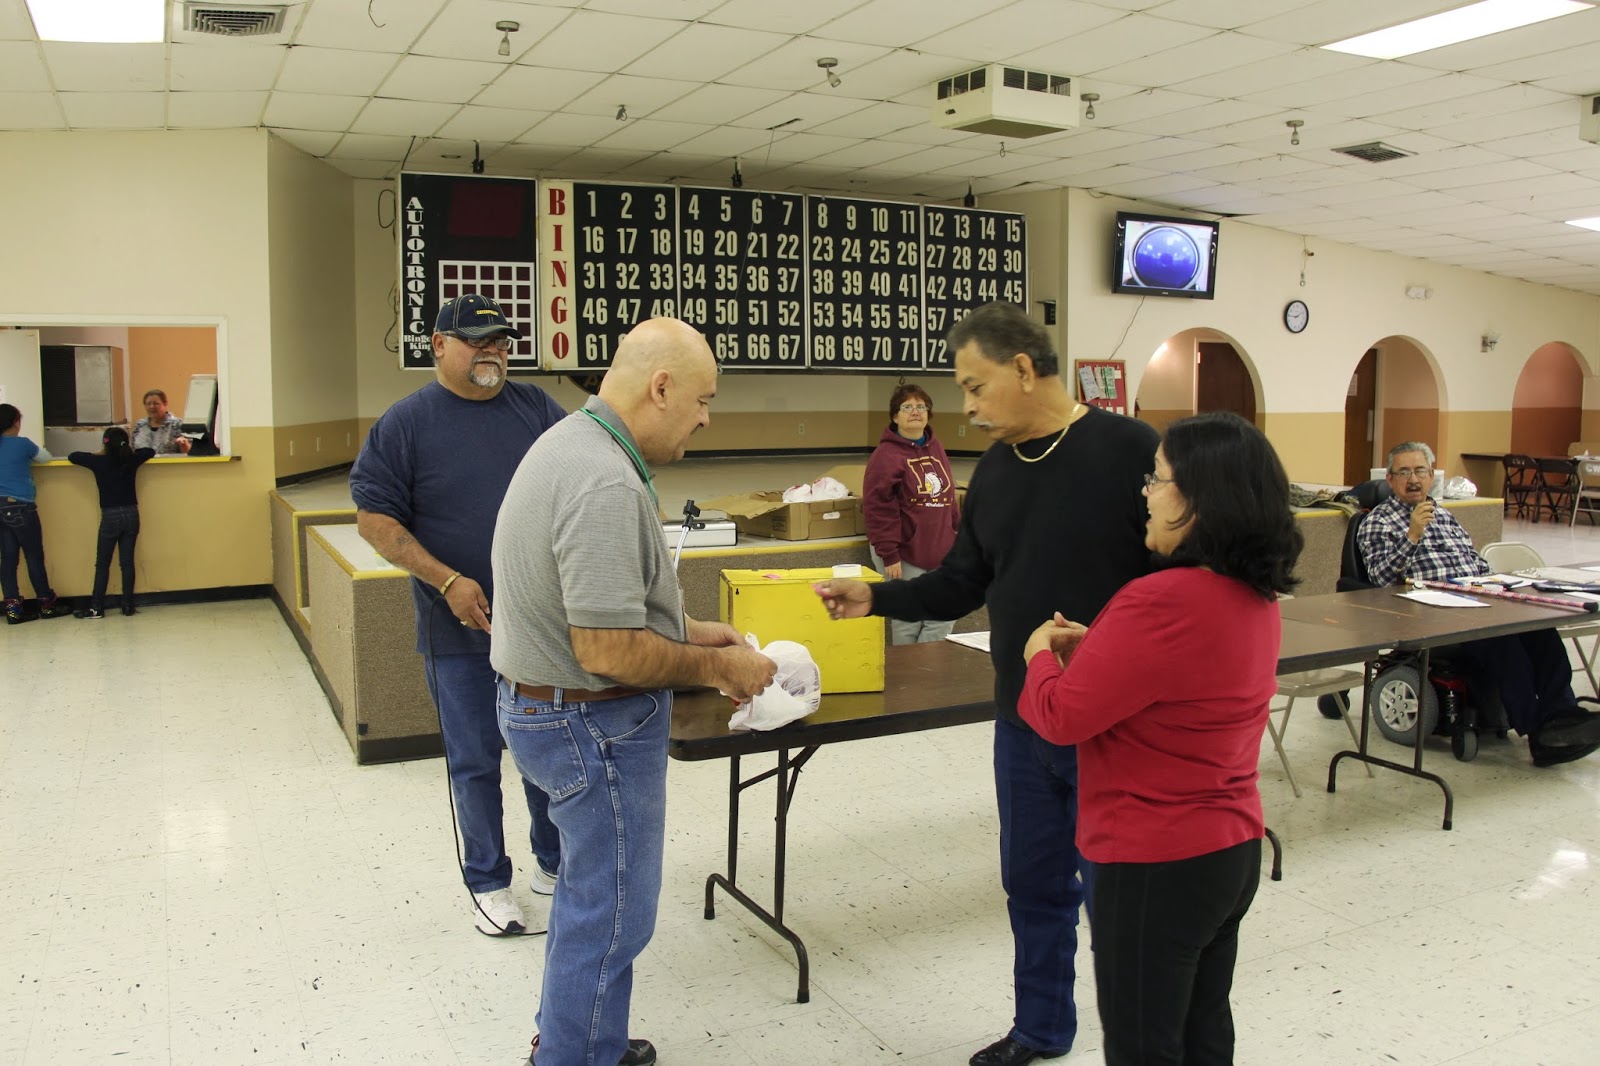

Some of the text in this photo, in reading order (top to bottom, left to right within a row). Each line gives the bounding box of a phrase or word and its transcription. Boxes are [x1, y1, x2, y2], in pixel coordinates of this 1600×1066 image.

[588, 191, 1020, 242] 1 2 3 4 5 6 7 8 9 10 11 12 13 14 15
[406, 197, 426, 334] AUTOTRONIC
[583, 226, 1021, 273] 16 17 18 19 20 21 22 23 24 25 26 27 28 29 30
[548, 188, 570, 360] BINGO
[584, 262, 1022, 303] 31 32 33 34 35 36 37 38 39 40 41 42 43 44 45
[583, 298, 607, 324] 46
[617, 299, 640, 324] 47
[651, 299, 675, 319] 48
[684, 298, 706, 324] 49
[716, 299, 738, 325] 50
[749, 300, 767, 325] 51
[779, 301, 799, 326] 52
[814, 302, 834, 327] 53
[842, 303, 863, 328] 54
[871, 304, 890, 328] 55
[899, 305, 918, 329] 56
[928, 307, 946, 331] 57
[586, 334, 607, 360] 61
[716, 334, 738, 360] 65
[748, 334, 770, 359] 66
[779, 335, 800, 360] 67
[815, 335, 835, 360] 68
[843, 336, 863, 361] 69
[872, 337, 891, 361] 70
[900, 338, 917, 361] 71
[928, 339, 947, 363] 72
